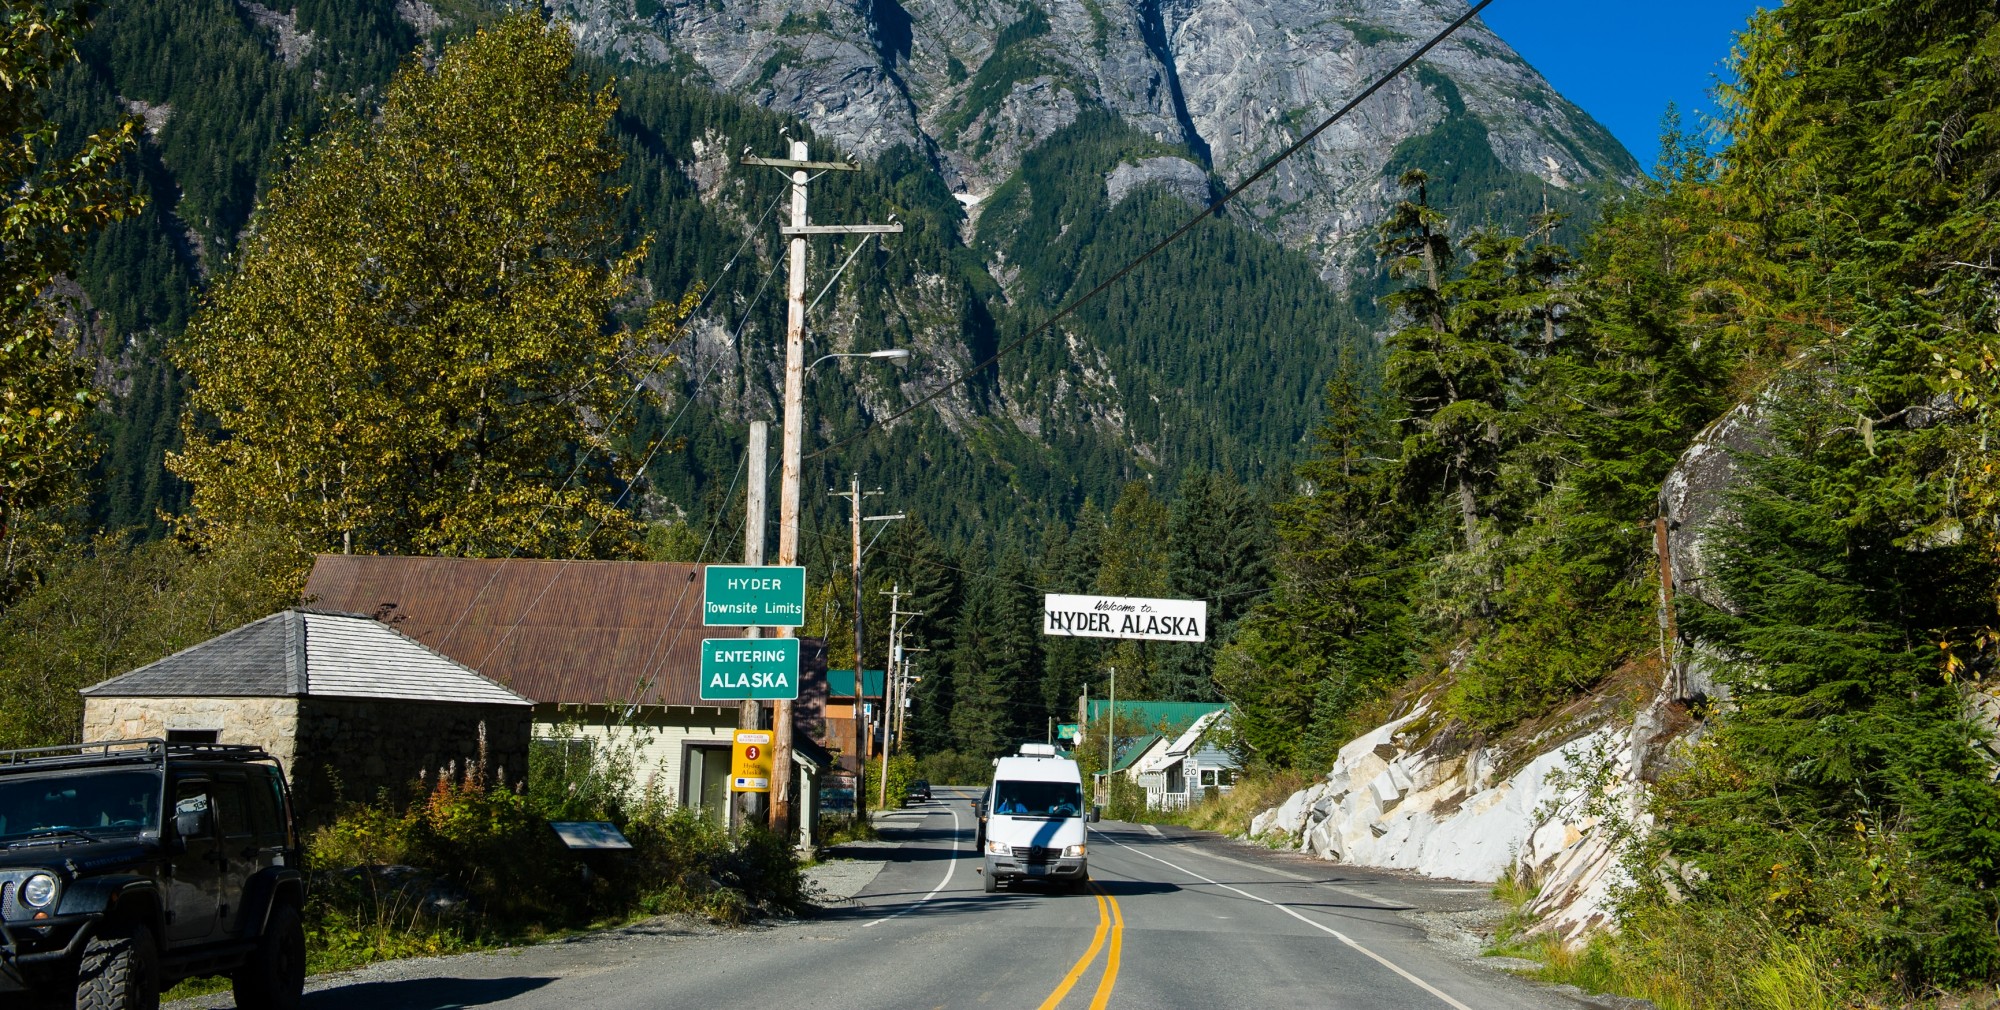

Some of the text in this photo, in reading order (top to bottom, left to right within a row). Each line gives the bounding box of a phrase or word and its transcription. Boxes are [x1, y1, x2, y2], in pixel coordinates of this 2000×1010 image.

[728, 578, 781, 590] HYDER
[706, 601, 802, 614] Townsite Limits
[1094, 600, 1136, 613] Welcome
[1120, 614, 1200, 637] ALASKA
[715, 650, 786, 662] ENTERING
[710, 672, 789, 688] ALASKA
[749, 747, 756, 759] 3
[1184, 768, 1197, 776] 20
